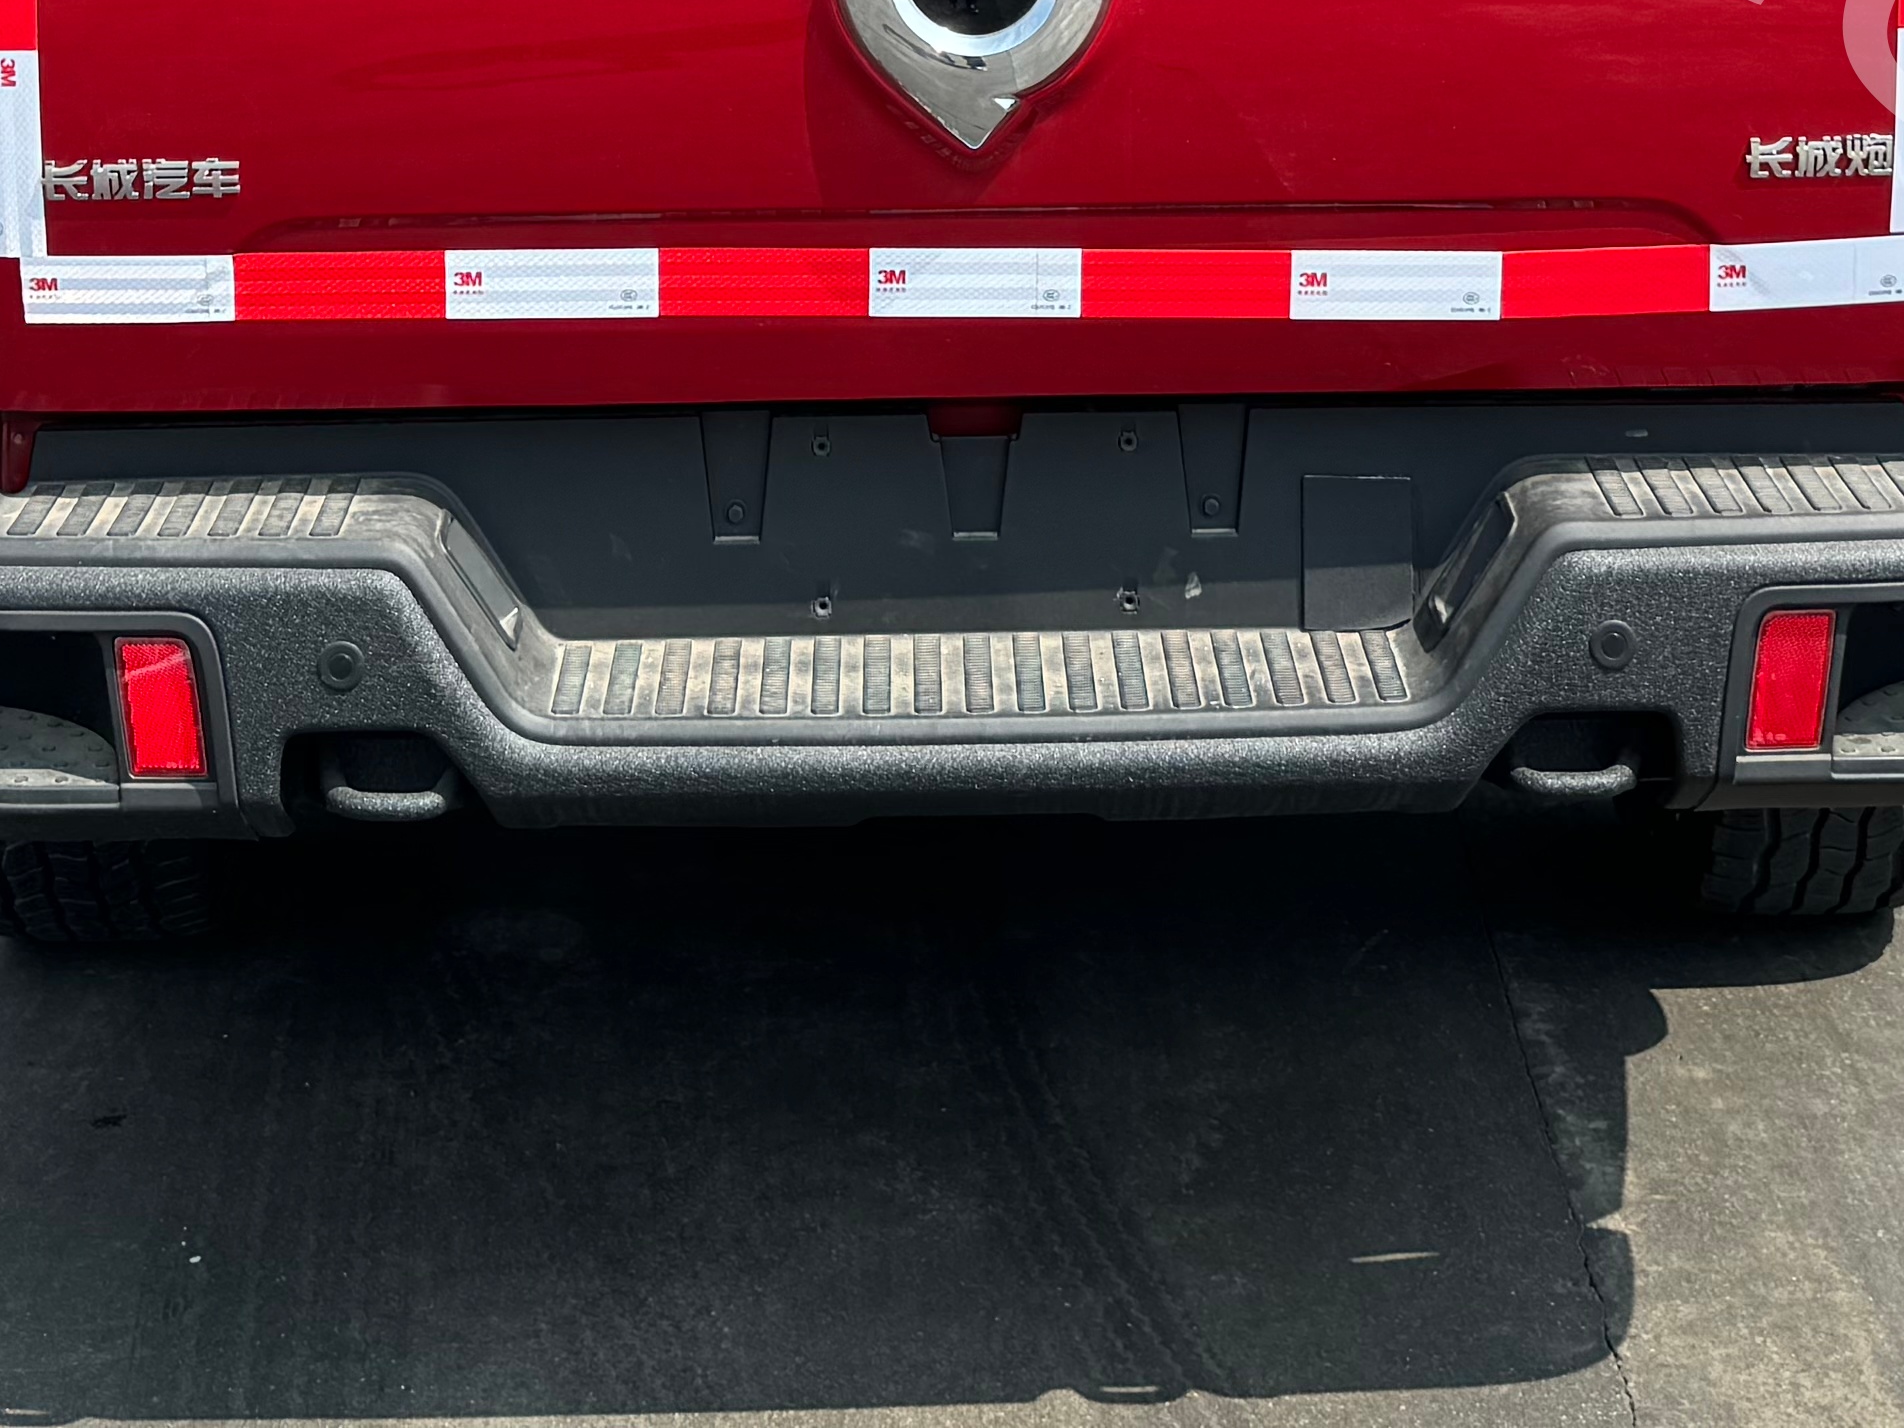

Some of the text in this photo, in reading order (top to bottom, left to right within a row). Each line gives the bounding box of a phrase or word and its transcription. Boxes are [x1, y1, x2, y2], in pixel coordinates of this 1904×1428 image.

[0, 57, 17, 87] 3M
[1746, 134, 1893, 178] 长城炮
[42, 157, 241, 200] 长城汽车
[453, 271, 483, 287] 3M
[877, 269, 907, 285] 3M
[1298, 271, 1328, 288] 3M
[1717, 264, 1747, 281] 3M
[29, 277, 59, 292] 3M
